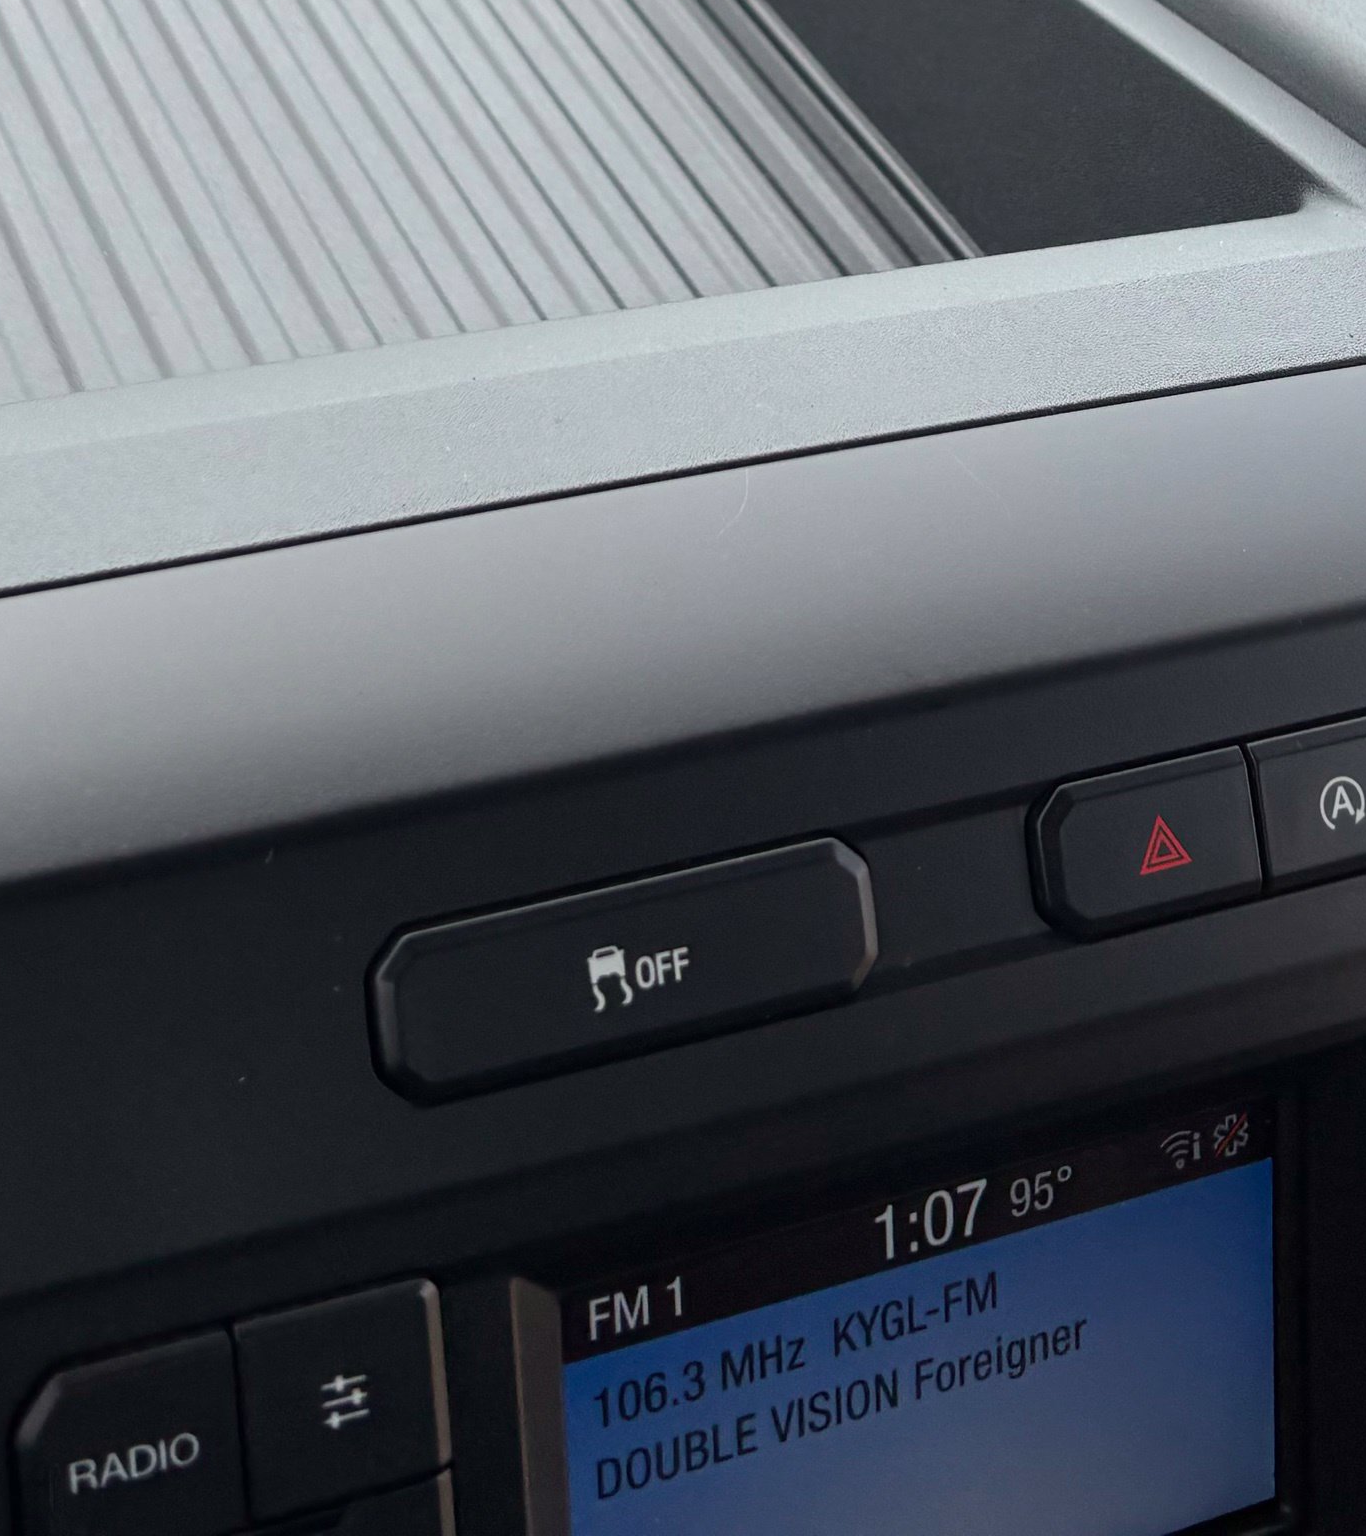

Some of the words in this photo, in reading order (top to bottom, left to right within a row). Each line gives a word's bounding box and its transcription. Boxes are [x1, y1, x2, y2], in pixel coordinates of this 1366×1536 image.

[635, 946, 690, 989] OFF
[874, 1178, 988, 1261] 1:07
[1009, 1165, 1073, 1218] 95°
[588, 1284, 650, 1341] FM
[666, 1275, 683, 1317] 1
[593, 1360, 706, 1429] 106.3
[720, 1334, 806, 1392] MHz
[833, 1271, 997, 1357] KYGL-FM
[596, 1413, 759, 1500] DOUBLE
[770, 1369, 898, 1443] VISION
[915, 1319, 1087, 1401] Foreigner
[68, 1432, 200, 1495] RADIO
